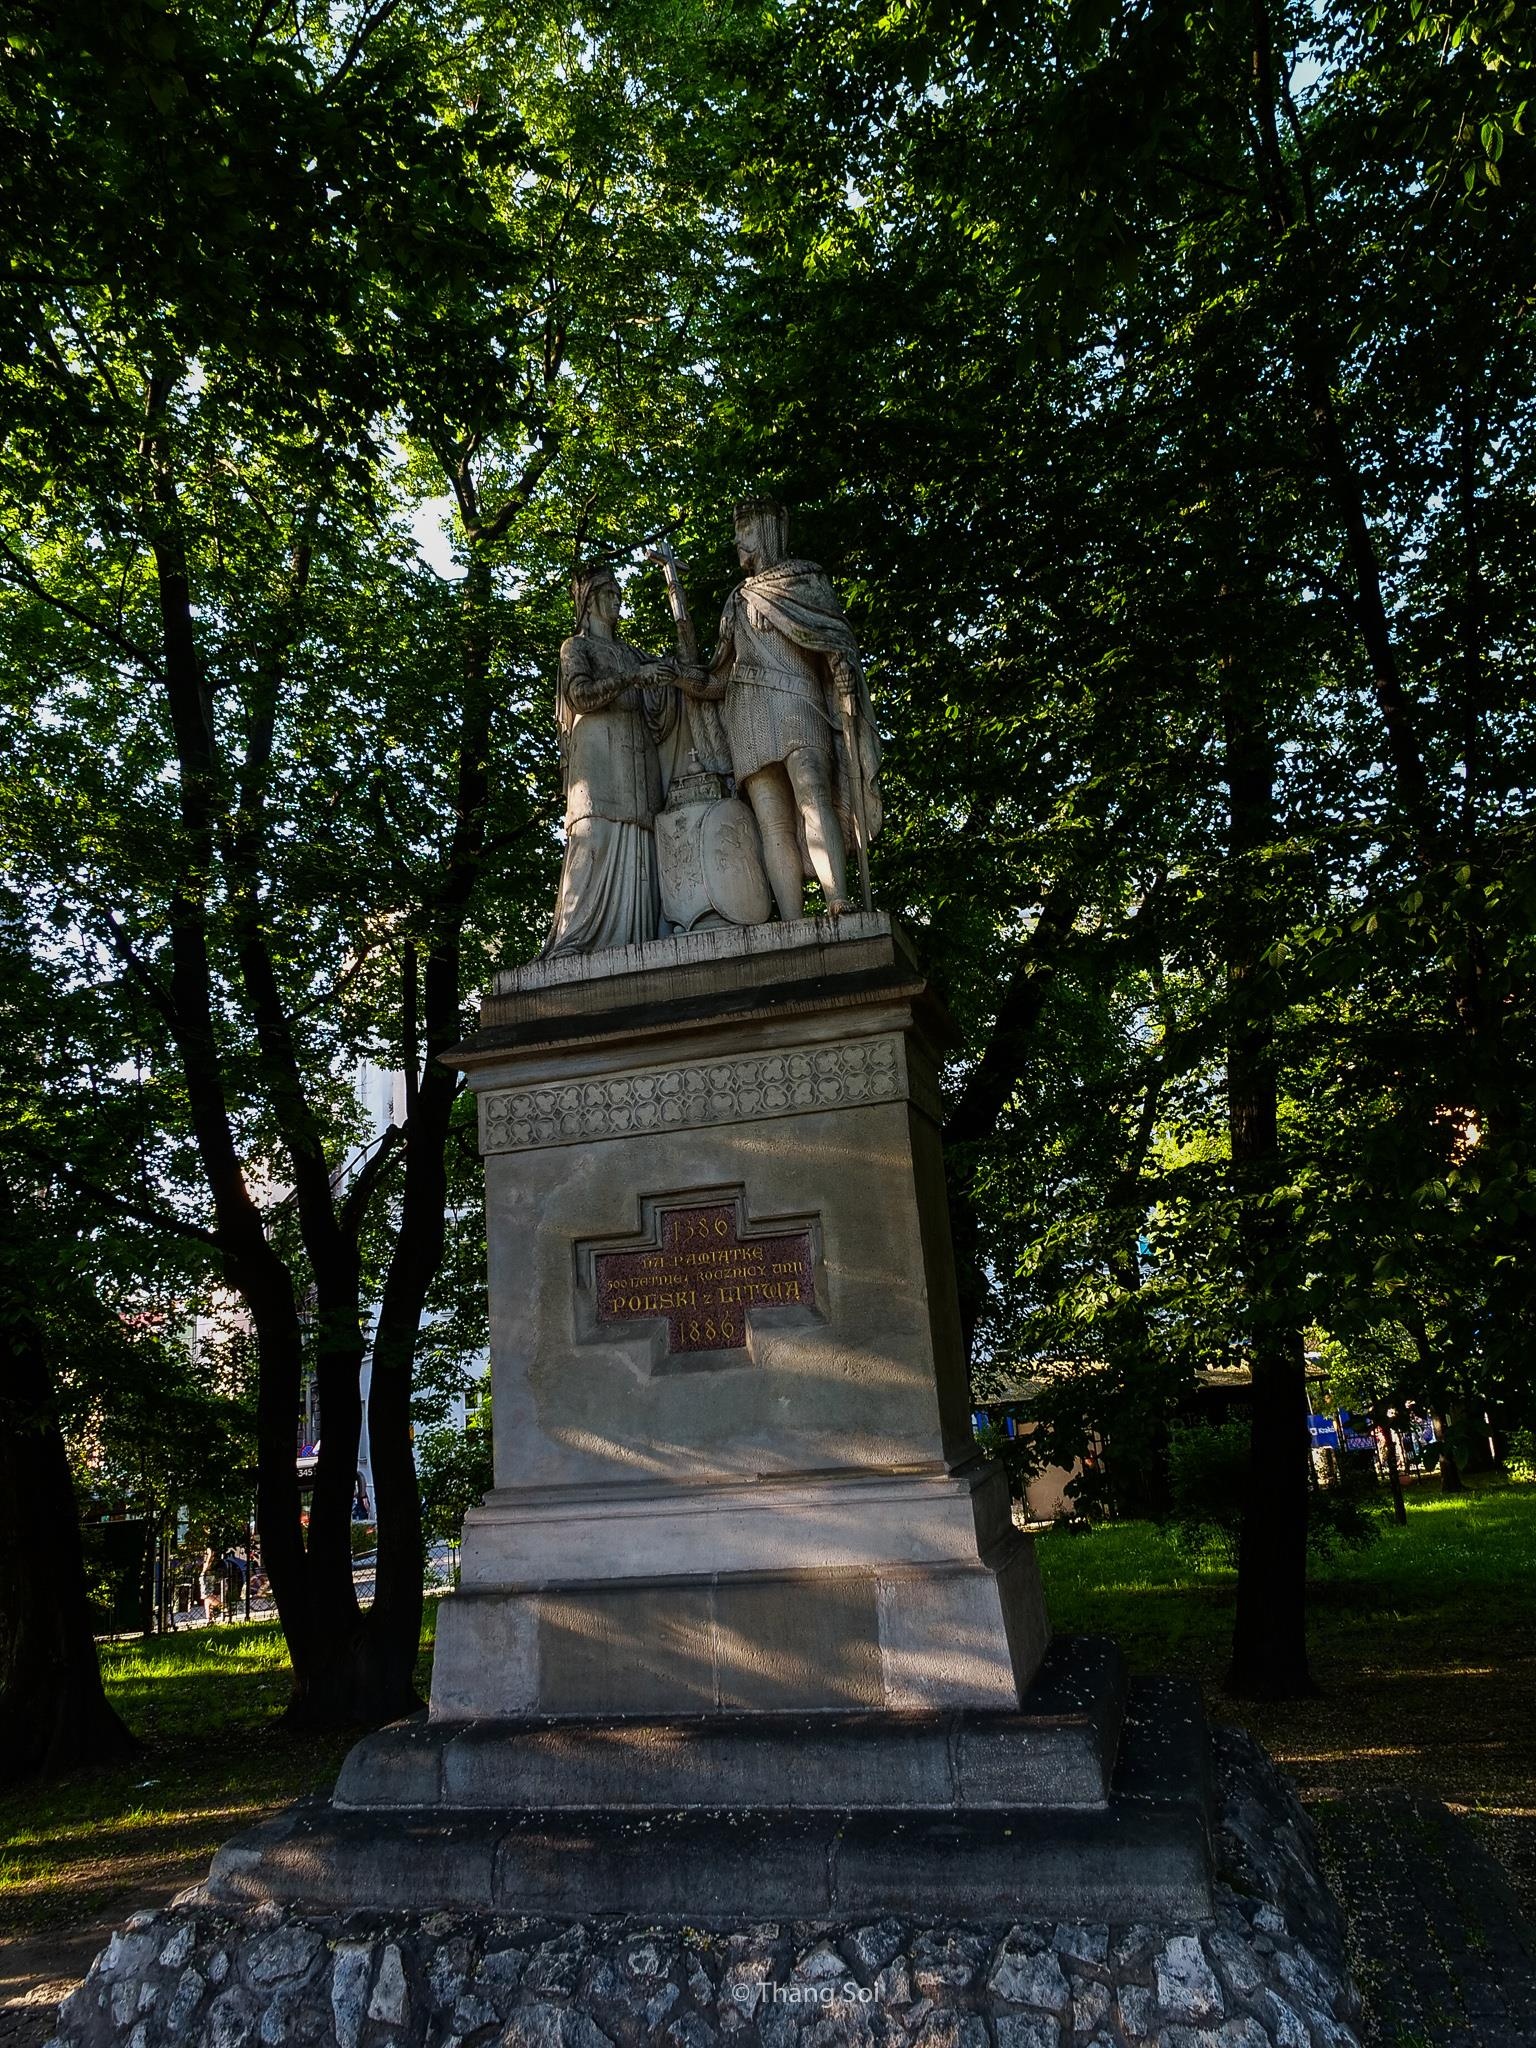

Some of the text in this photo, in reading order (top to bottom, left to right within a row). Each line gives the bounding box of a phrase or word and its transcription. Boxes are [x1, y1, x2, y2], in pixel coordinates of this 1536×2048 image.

[673, 1216, 728, 1243] 1386
[643, 1246, 764, 1269] NA PAMIĄTKĘ
[696, 1265, 766, 1281] ROCZNICY
[771, 1261, 803, 1275] UNII
[612, 1290, 697, 1312] POLSKI
[718, 1280, 801, 1303] LITWĄ
[679, 1311, 735, 1344] 1886
